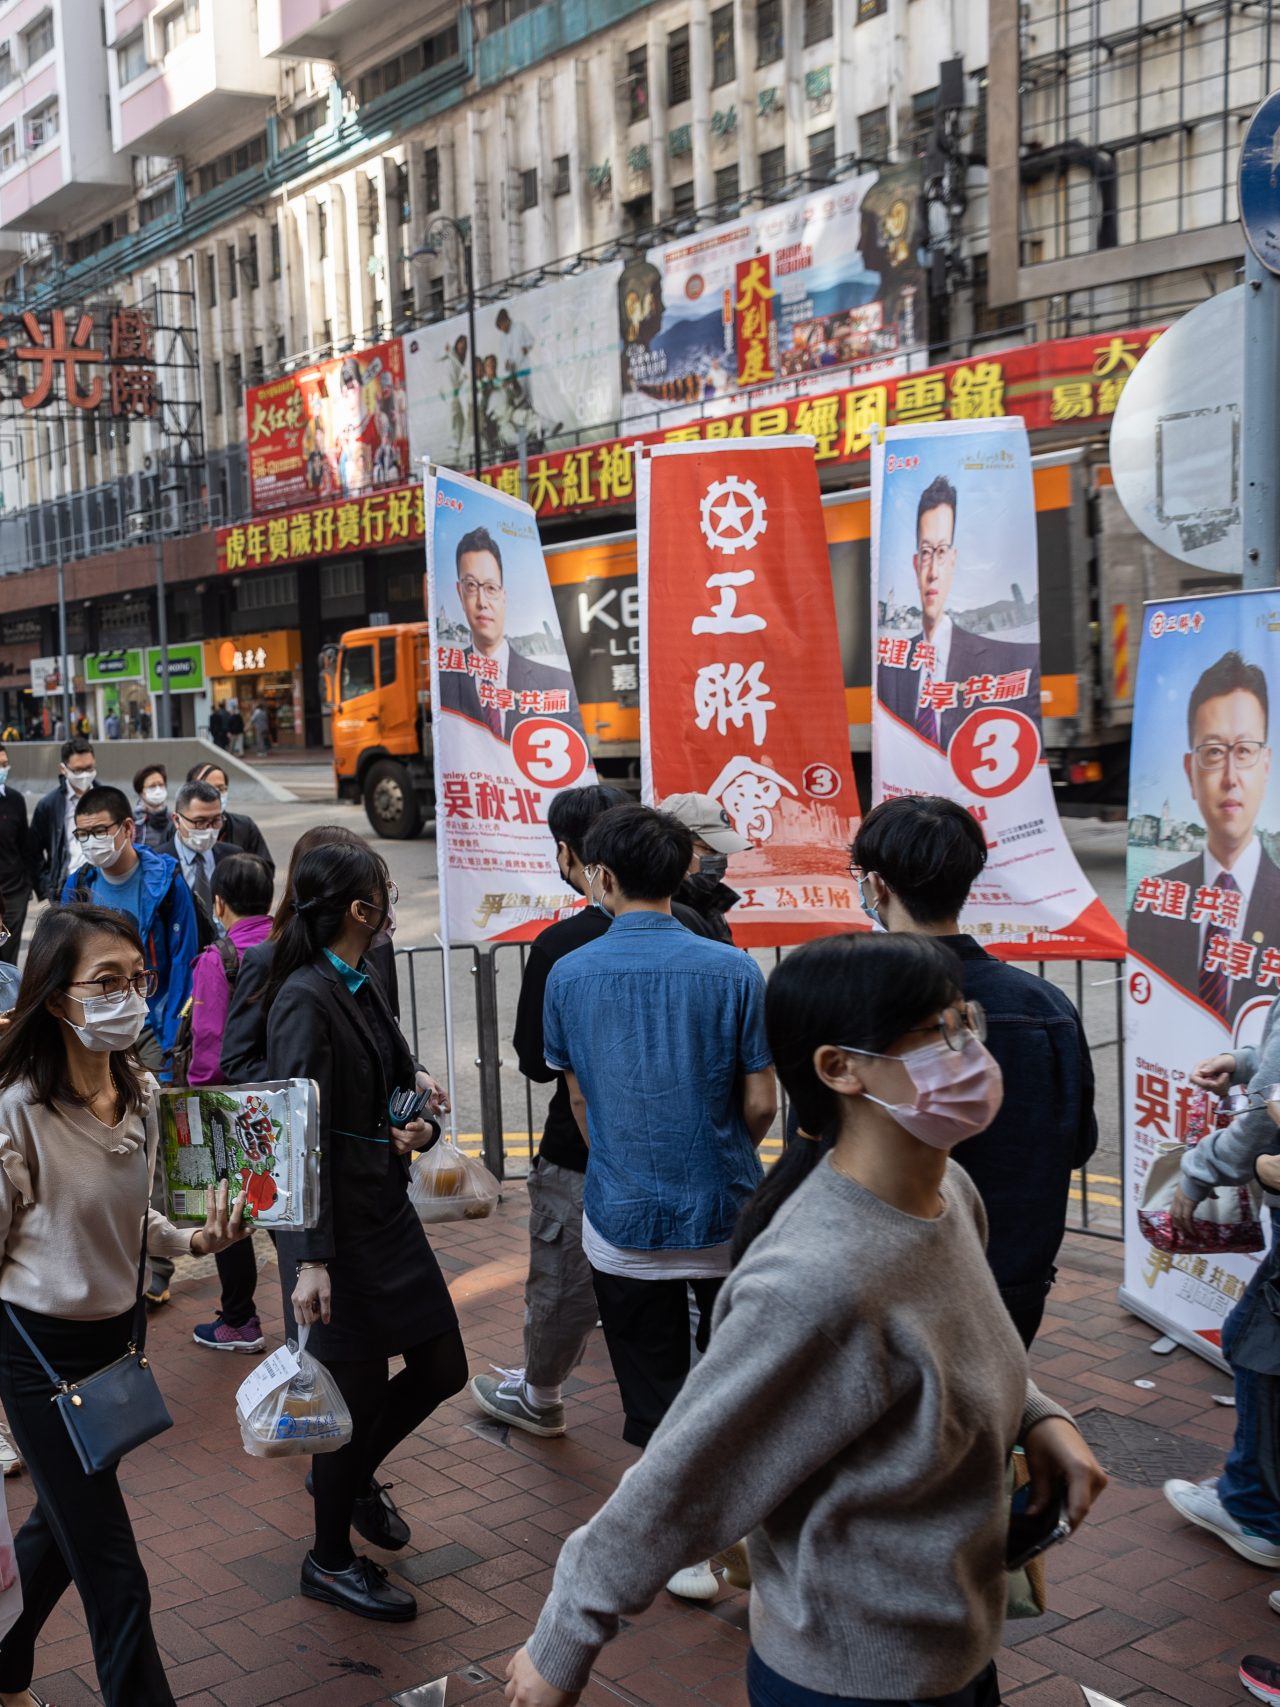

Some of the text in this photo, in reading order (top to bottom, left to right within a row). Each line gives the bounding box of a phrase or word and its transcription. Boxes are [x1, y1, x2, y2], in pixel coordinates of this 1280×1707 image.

[225, 486, 427, 571] 虎年賀歲孖寶行好
[478, 684, 570, 713] 共享 共贏
[691, 568, 800, 842] 工聯會
[962, 668, 1031, 708] 共贏
[526, 727, 572, 782] 3
[971, 718, 1021, 792] 3
[442, 780, 549, 825] 吳秋北
[814, 768, 833, 794] 3
[1133, 877, 1242, 930] 共建 共榮
[1205, 936, 1256, 978] 共享
[1132, 975, 1147, 1001] 3
